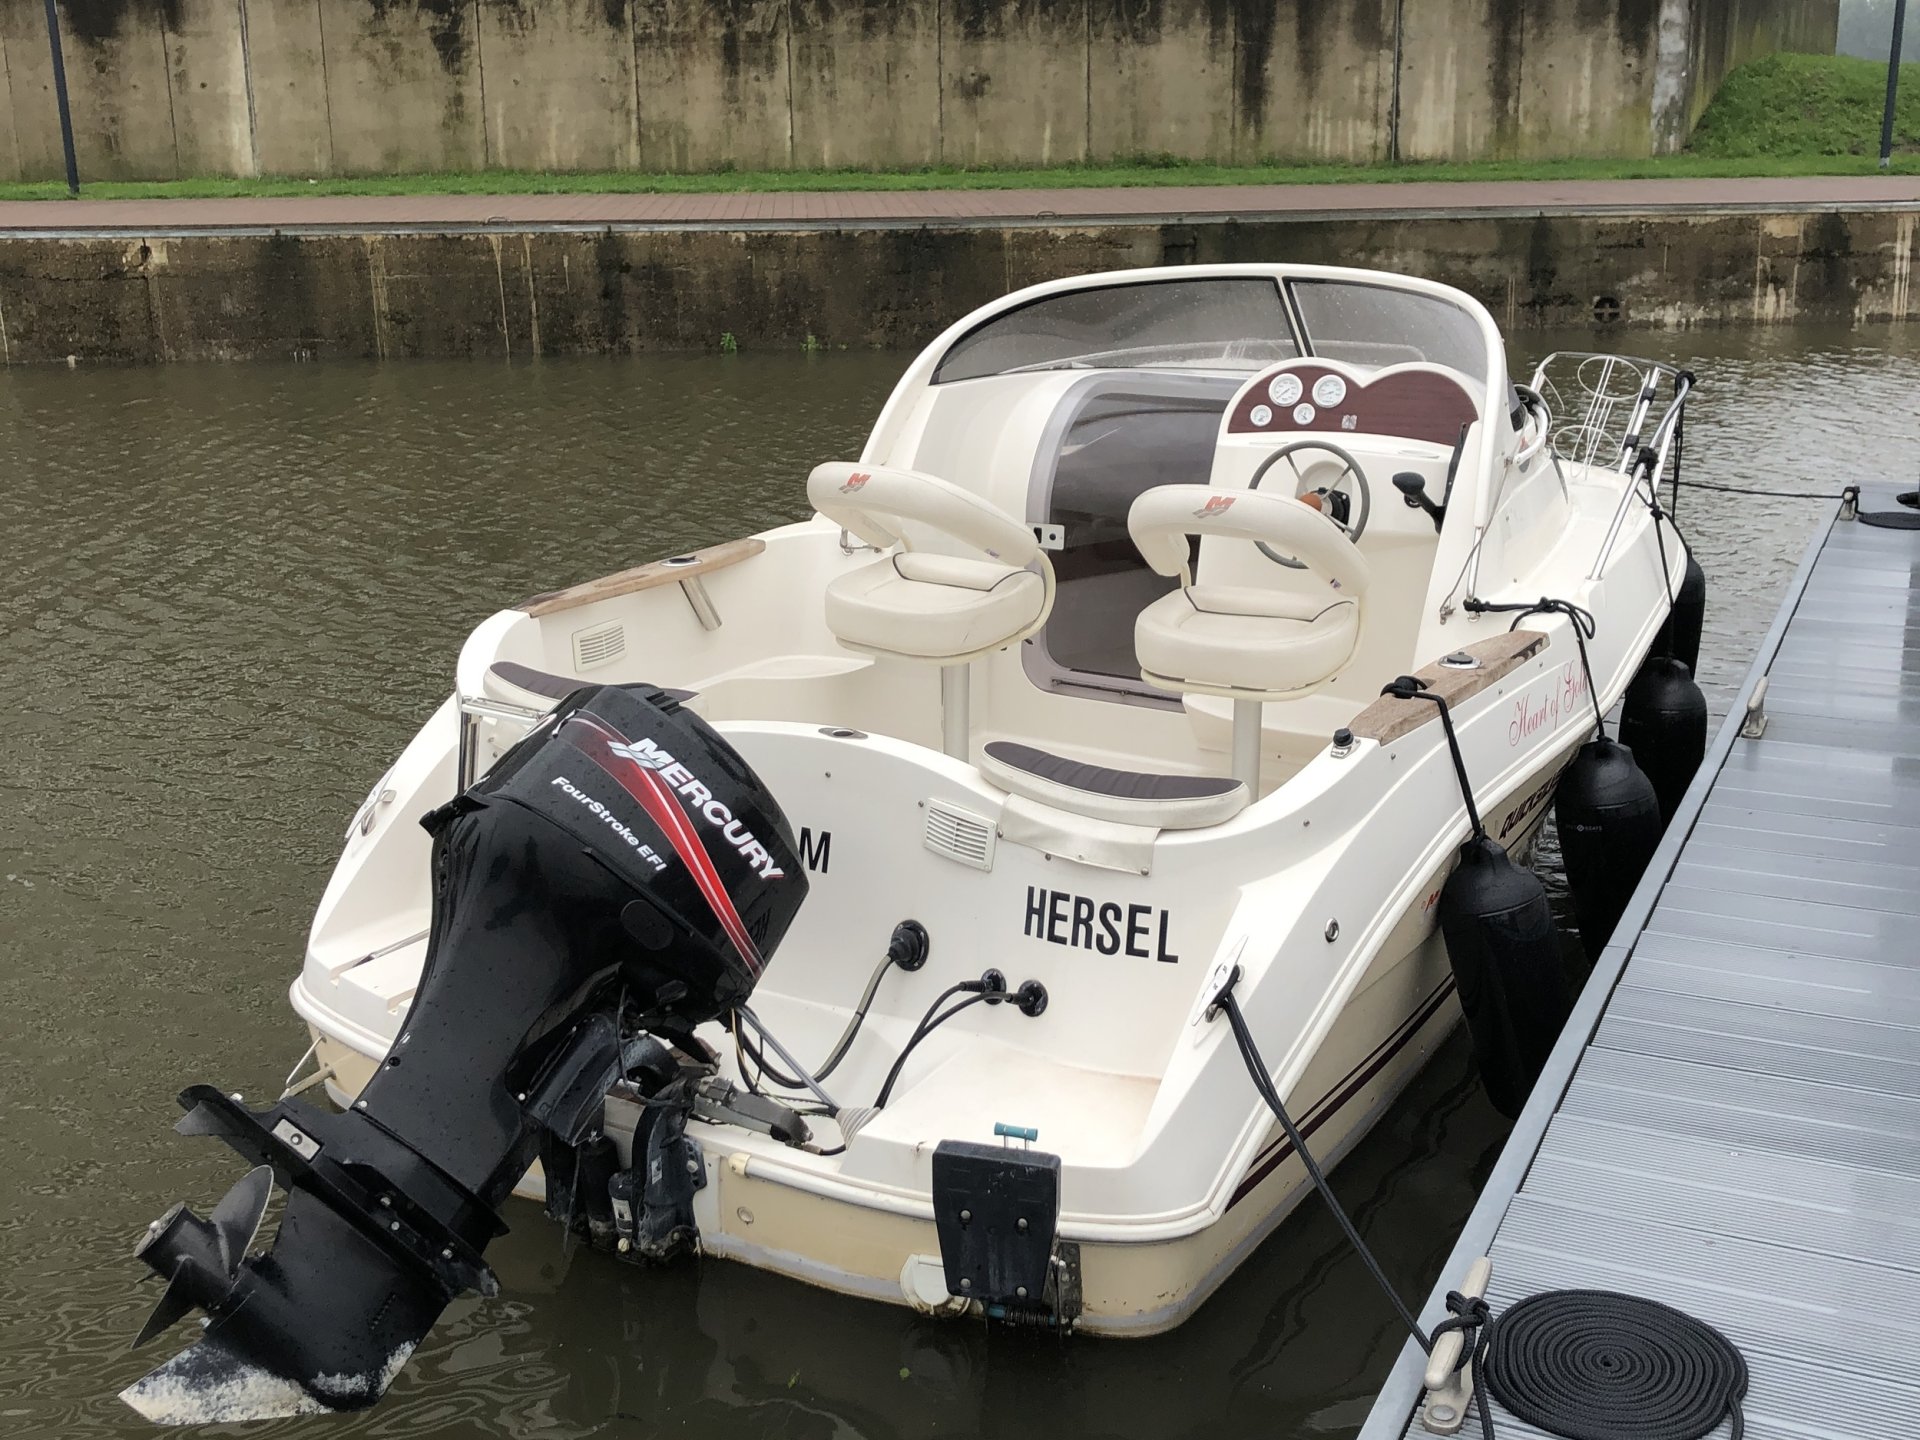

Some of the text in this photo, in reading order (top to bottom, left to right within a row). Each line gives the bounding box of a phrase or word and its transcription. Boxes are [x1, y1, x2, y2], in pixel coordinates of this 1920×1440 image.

[1509, 693, 1548, 747] Heart
[1551, 675, 1561, 731] of
[551, 776, 668, 872] FourStroke EFI
[628, 738, 785, 880] MERCURY
[1024, 885, 1179, 964] HERSEL
